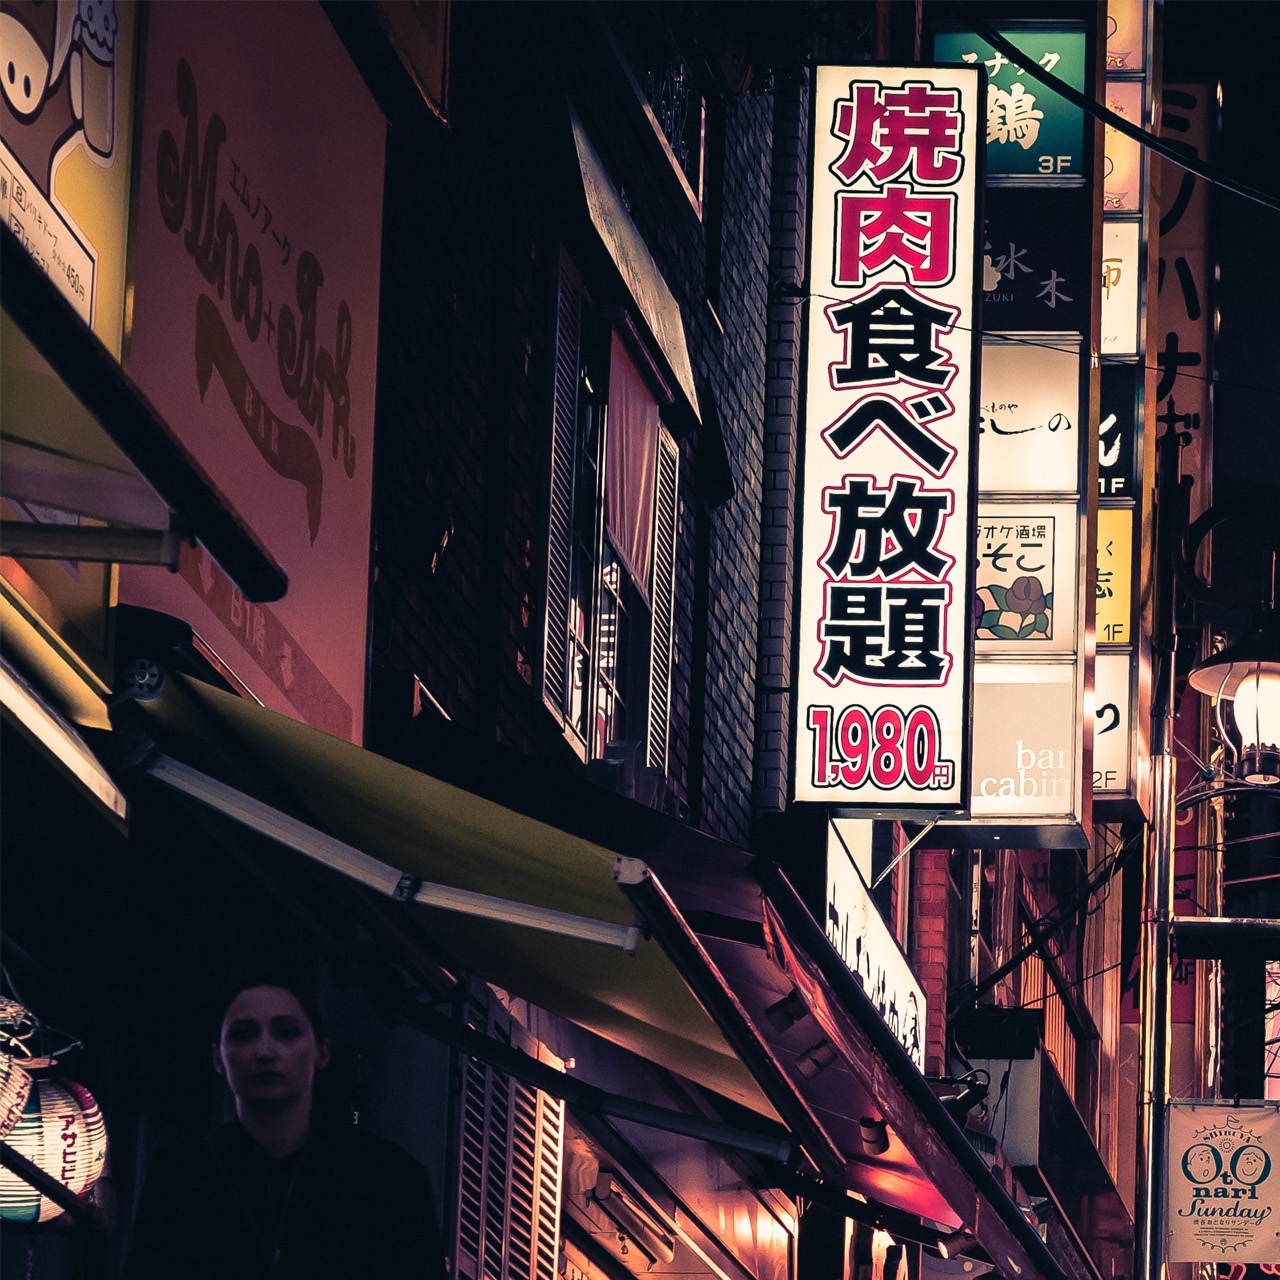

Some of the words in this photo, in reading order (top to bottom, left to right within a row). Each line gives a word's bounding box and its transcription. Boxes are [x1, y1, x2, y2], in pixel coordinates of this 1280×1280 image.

[961, 51, 1061, 78] スナク
[1038, 156, 1071, 173] 3F
[814, 80, 965, 687] 焼肉食べ放題
[979, 413, 1072, 435] しの
[976, 543, 1046, 573] そこ
[1103, 624, 1124, 641] 1F
[807, 704, 955, 789] 1,980円
[1016, 740, 1073, 770] bar
[980, 768, 1073, 799] cabin
[1192, 1184, 1259, 1200] nari
[1178, 1199, 1272, 1226] Sunday
